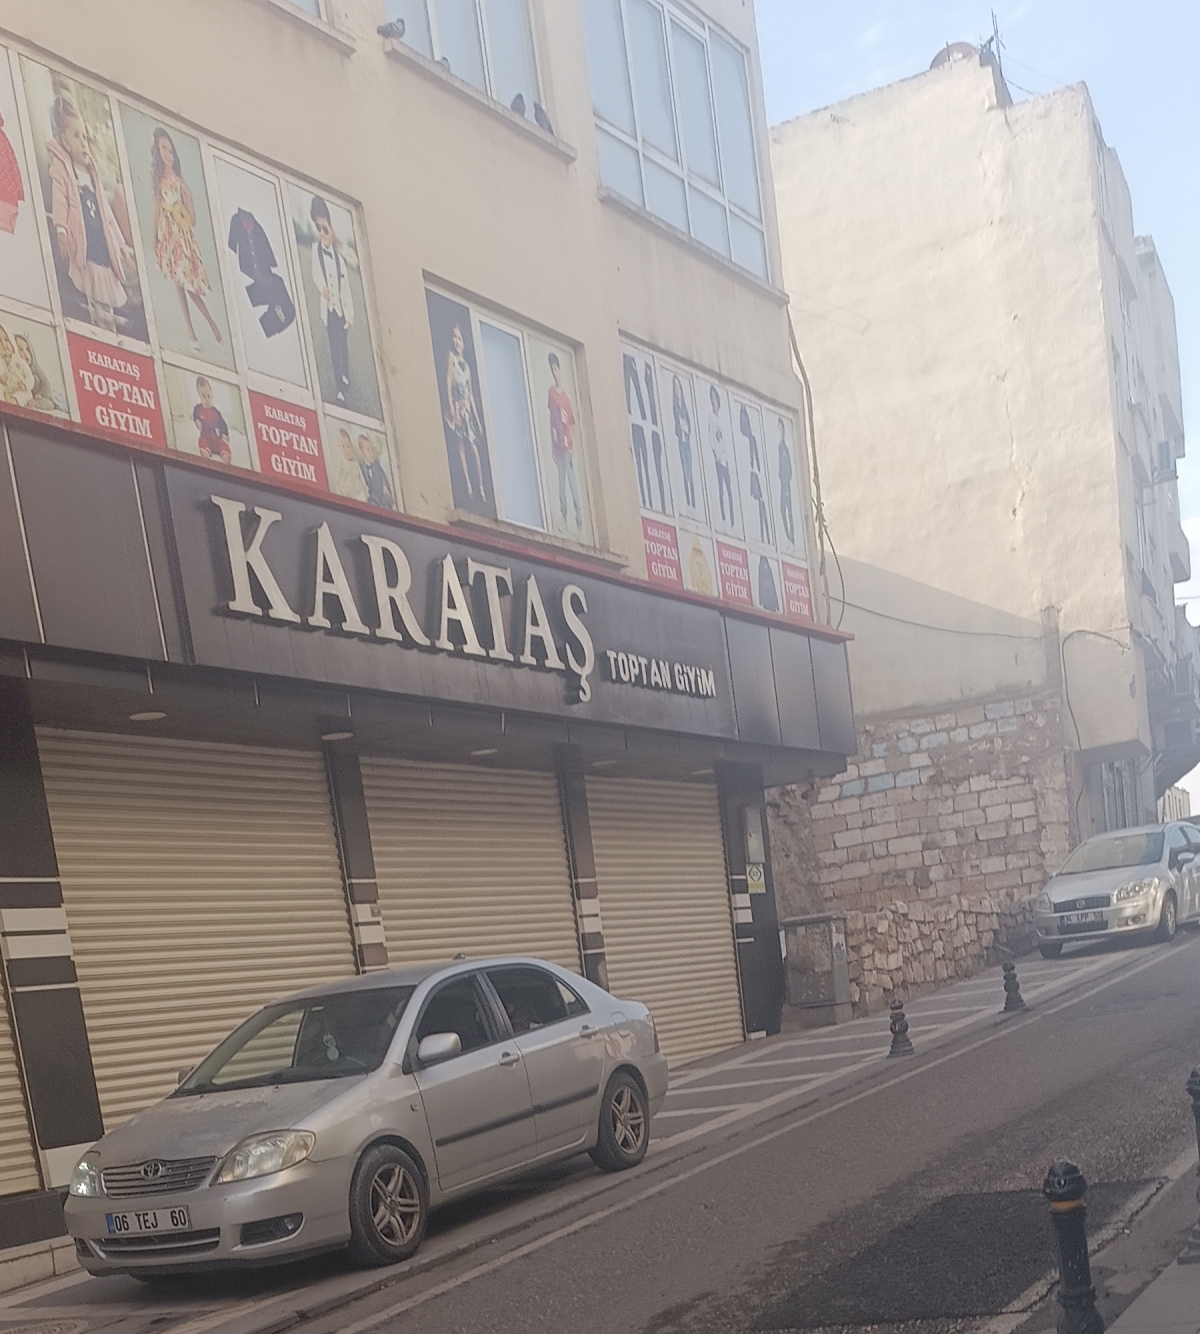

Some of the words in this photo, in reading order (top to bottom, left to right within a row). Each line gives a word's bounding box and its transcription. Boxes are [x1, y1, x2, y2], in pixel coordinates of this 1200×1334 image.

[87, 350, 141, 381] KARATAŞ
[79, 369, 155, 411] TOPTAN
[95, 403, 153, 439] GİYİM
[263, 404, 307, 429] KARATAŞ
[257, 421, 319, 457] TOPTAN
[271, 451, 317, 482] GİYİM
[644, 540, 679, 562] TOPTAN
[651, 559, 678, 581] GİYİM
[719, 561, 749, 582] TOPTAN
[211, 495, 595, 703] KARATAŞ
[725, 580, 748, 600] GİYİM
[784, 581, 810, 599] TOPTAN
[673, 662, 717, 698] GİYİM
[114, 1214, 130, 1232] 06
[135, 1211, 159, 1231] TEJ
[170, 1209, 187, 1227] 60
